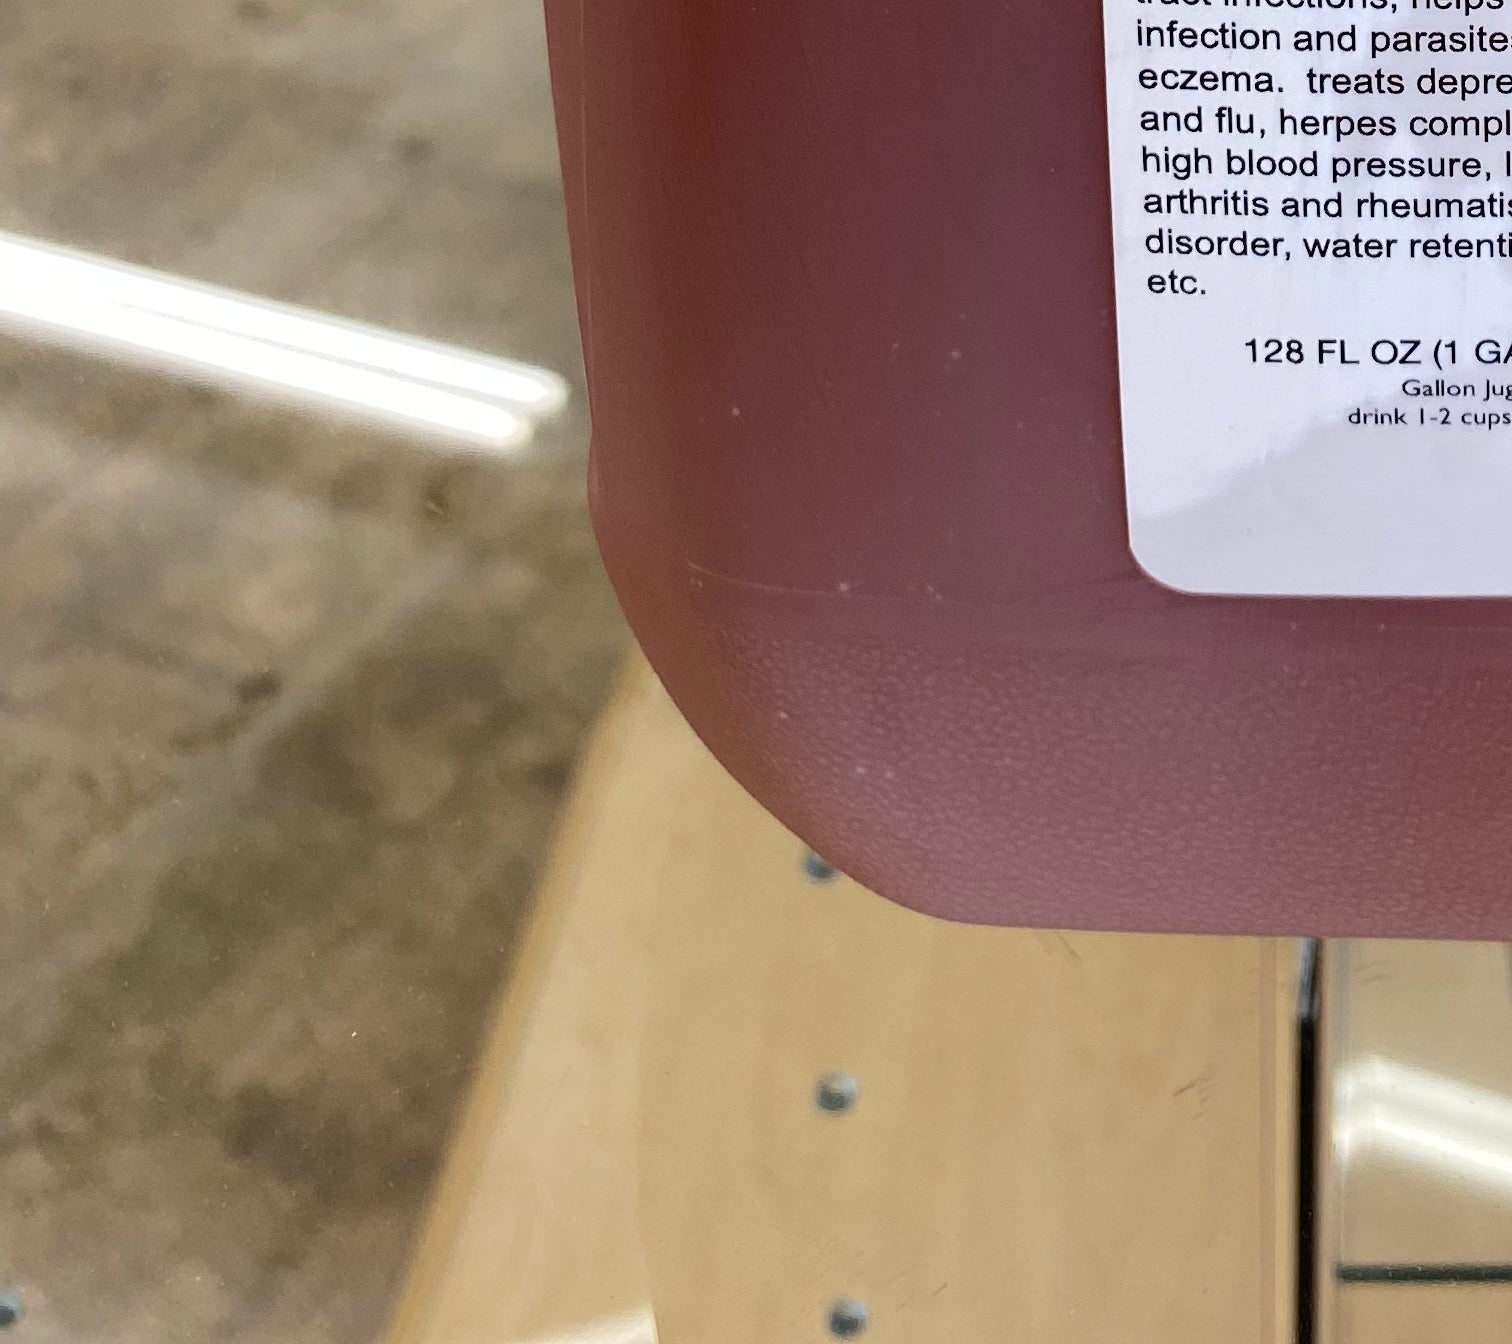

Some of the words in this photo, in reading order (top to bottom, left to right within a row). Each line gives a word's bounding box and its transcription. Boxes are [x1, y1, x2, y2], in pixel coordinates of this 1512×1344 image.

[1136, 17, 1281, 51] infection
[1291, 23, 1357, 54] and
[1137, 67, 1285, 94] eczema.
[1305, 66, 1406, 96] treats
[1139, 104, 1204, 134] and
[1214, 104, 1266, 140] flu,
[1279, 106, 1398, 144] herpes
[1141, 143, 1213, 182] high
[1225, 147, 1319, 178] blood
[1331, 155, 1492, 185] pressure,
[1143, 187, 1270, 218] arthritis
[1280, 190, 1343, 220] and
[1144, 226, 1291, 262] disorder,
[1301, 232, 1399, 260] water
[1146, 268, 1208, 296] etc.
[1244, 336, 1305, 366] 128
[1317, 338, 1361, 366] FL
[1369, 338, 1423, 366] OZ
[1432, 338, 1457, 372] (1
[1400, 377, 1476, 398] Gallon
[1347, 406, 1409, 426] drink
[1419, 406, 1452, 426] 1-2
[1460, 411, 1512, 432] cups
